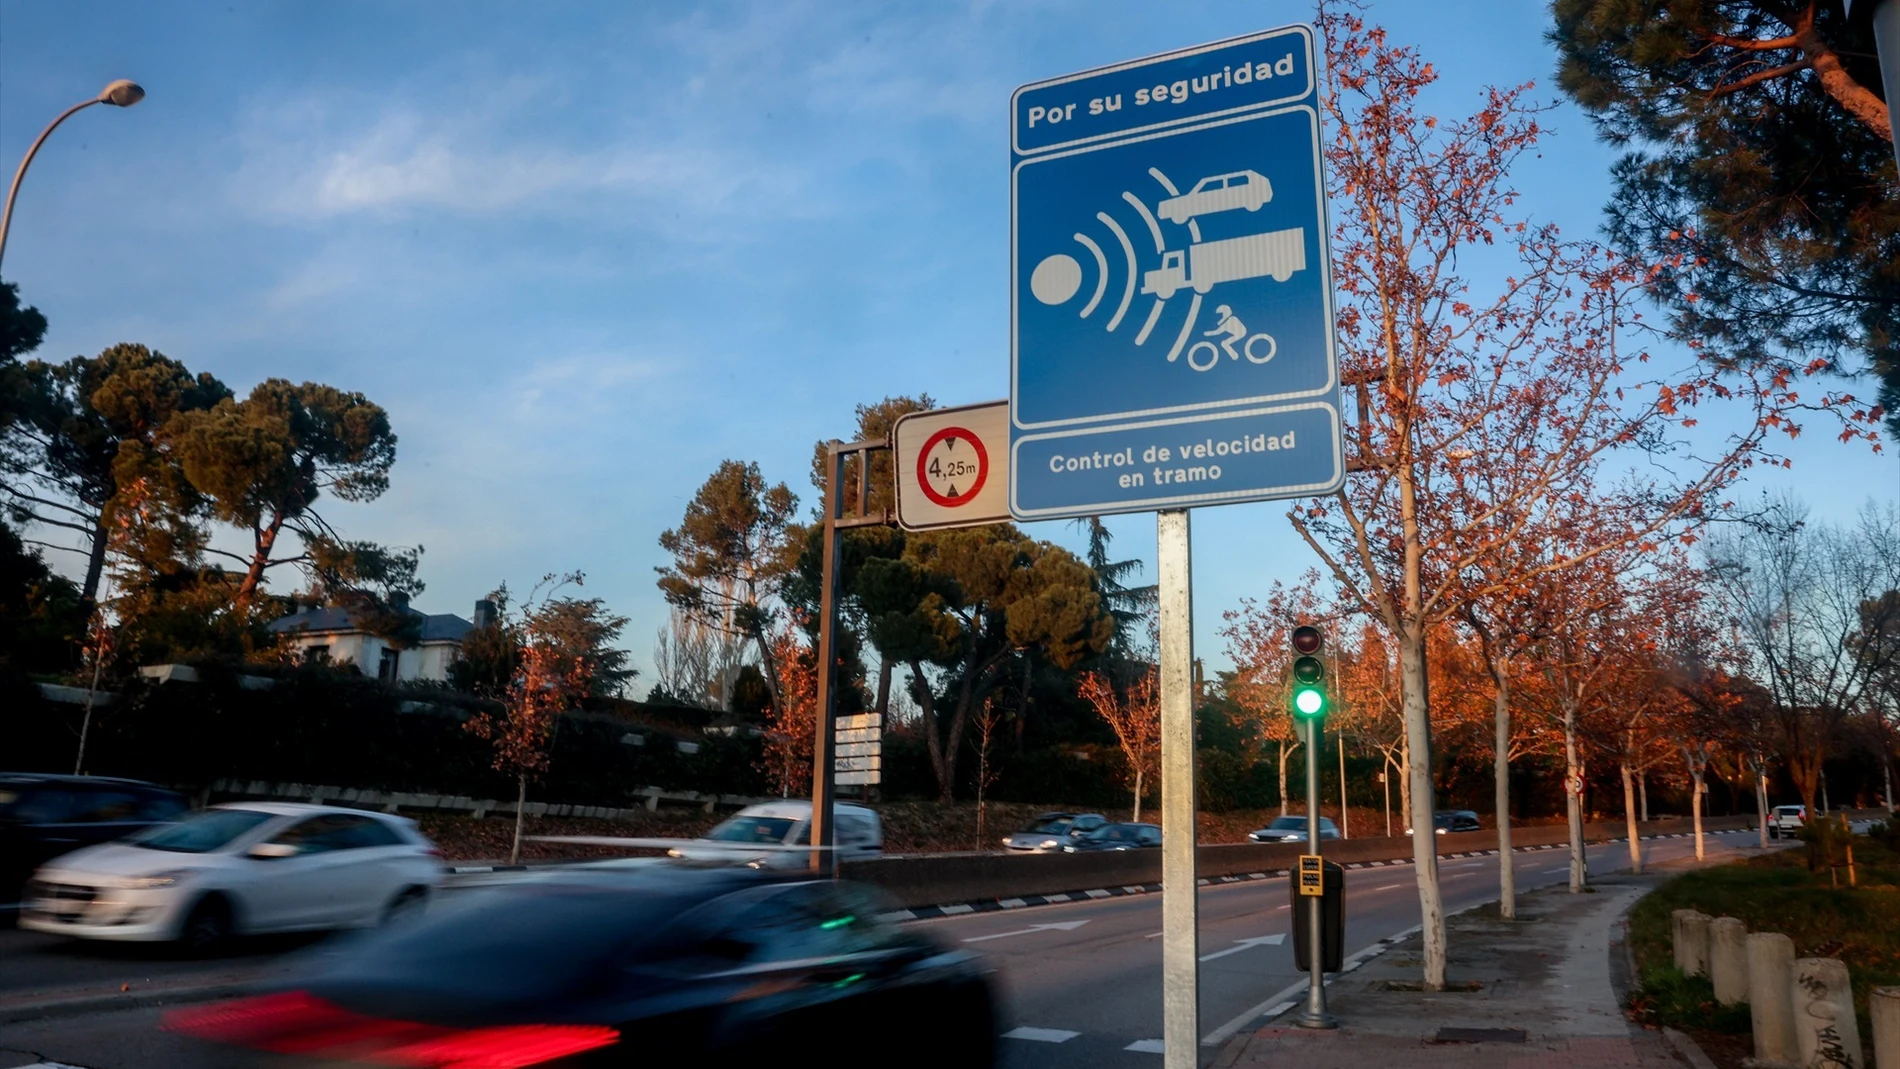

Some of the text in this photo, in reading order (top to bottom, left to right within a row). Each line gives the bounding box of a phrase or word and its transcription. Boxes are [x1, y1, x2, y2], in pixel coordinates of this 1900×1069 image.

[1028, 53, 1294, 128] Por su seguridad
[1049, 431, 1296, 473] Control de velocidad
[1118, 465, 1222, 488] en tramo
